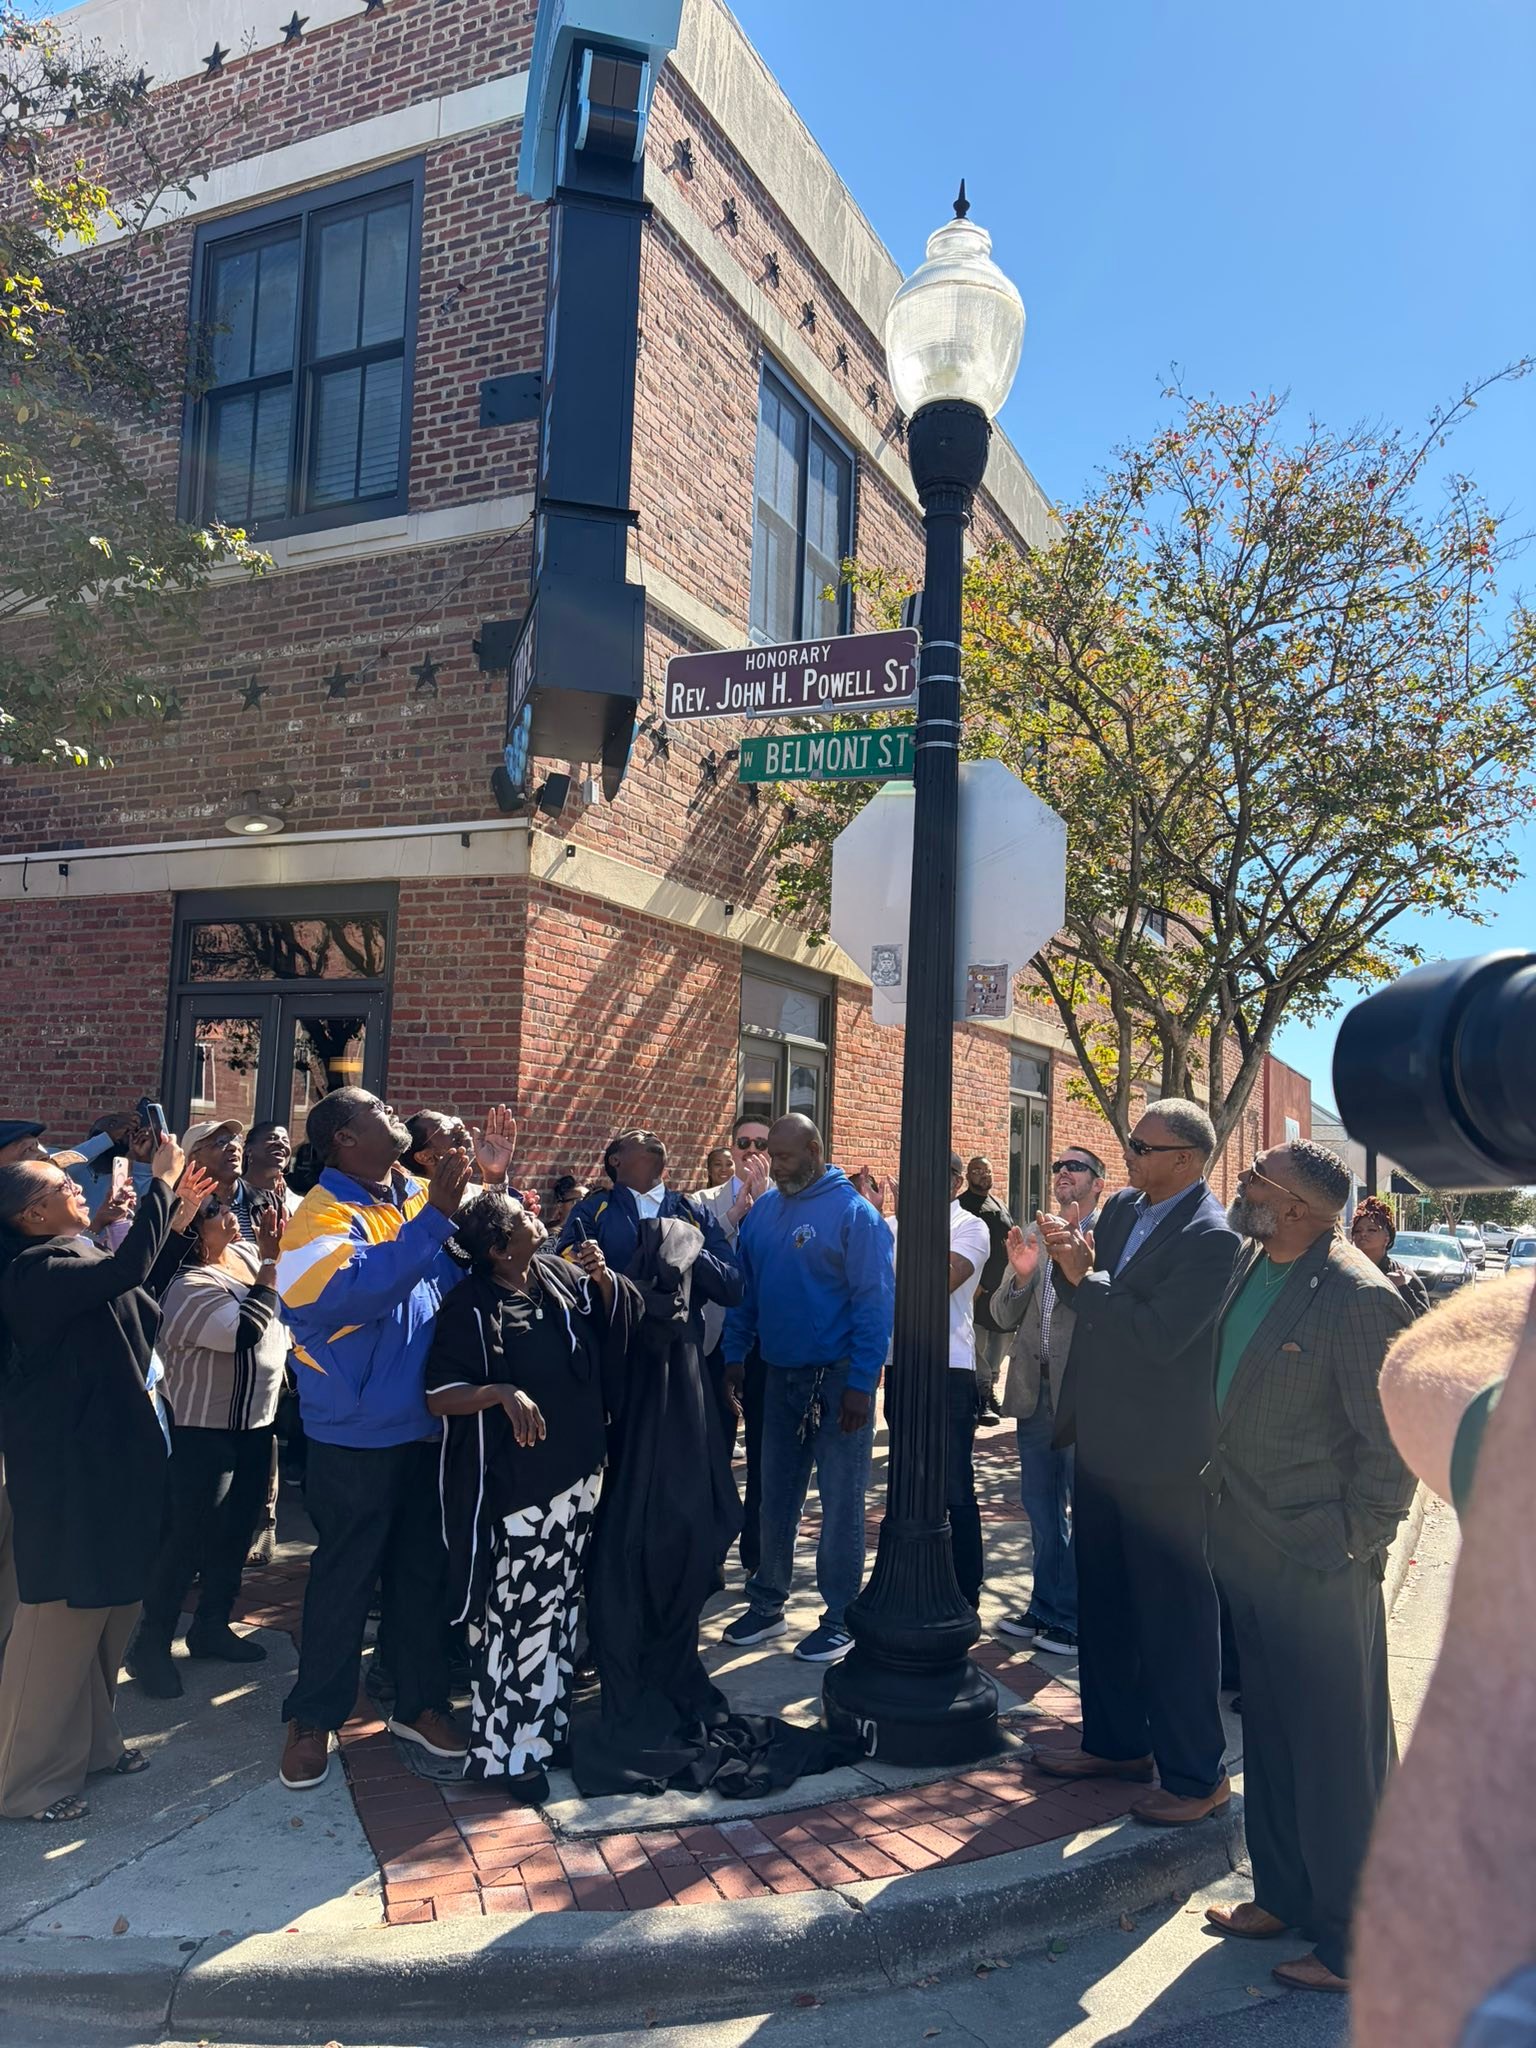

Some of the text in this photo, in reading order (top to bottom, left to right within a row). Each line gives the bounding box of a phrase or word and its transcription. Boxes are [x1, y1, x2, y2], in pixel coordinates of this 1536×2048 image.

[745, 644, 831, 671] HONORARY
[771, 671, 792, 704] H.
[743, 732, 909, 774] W BELMONT ST
